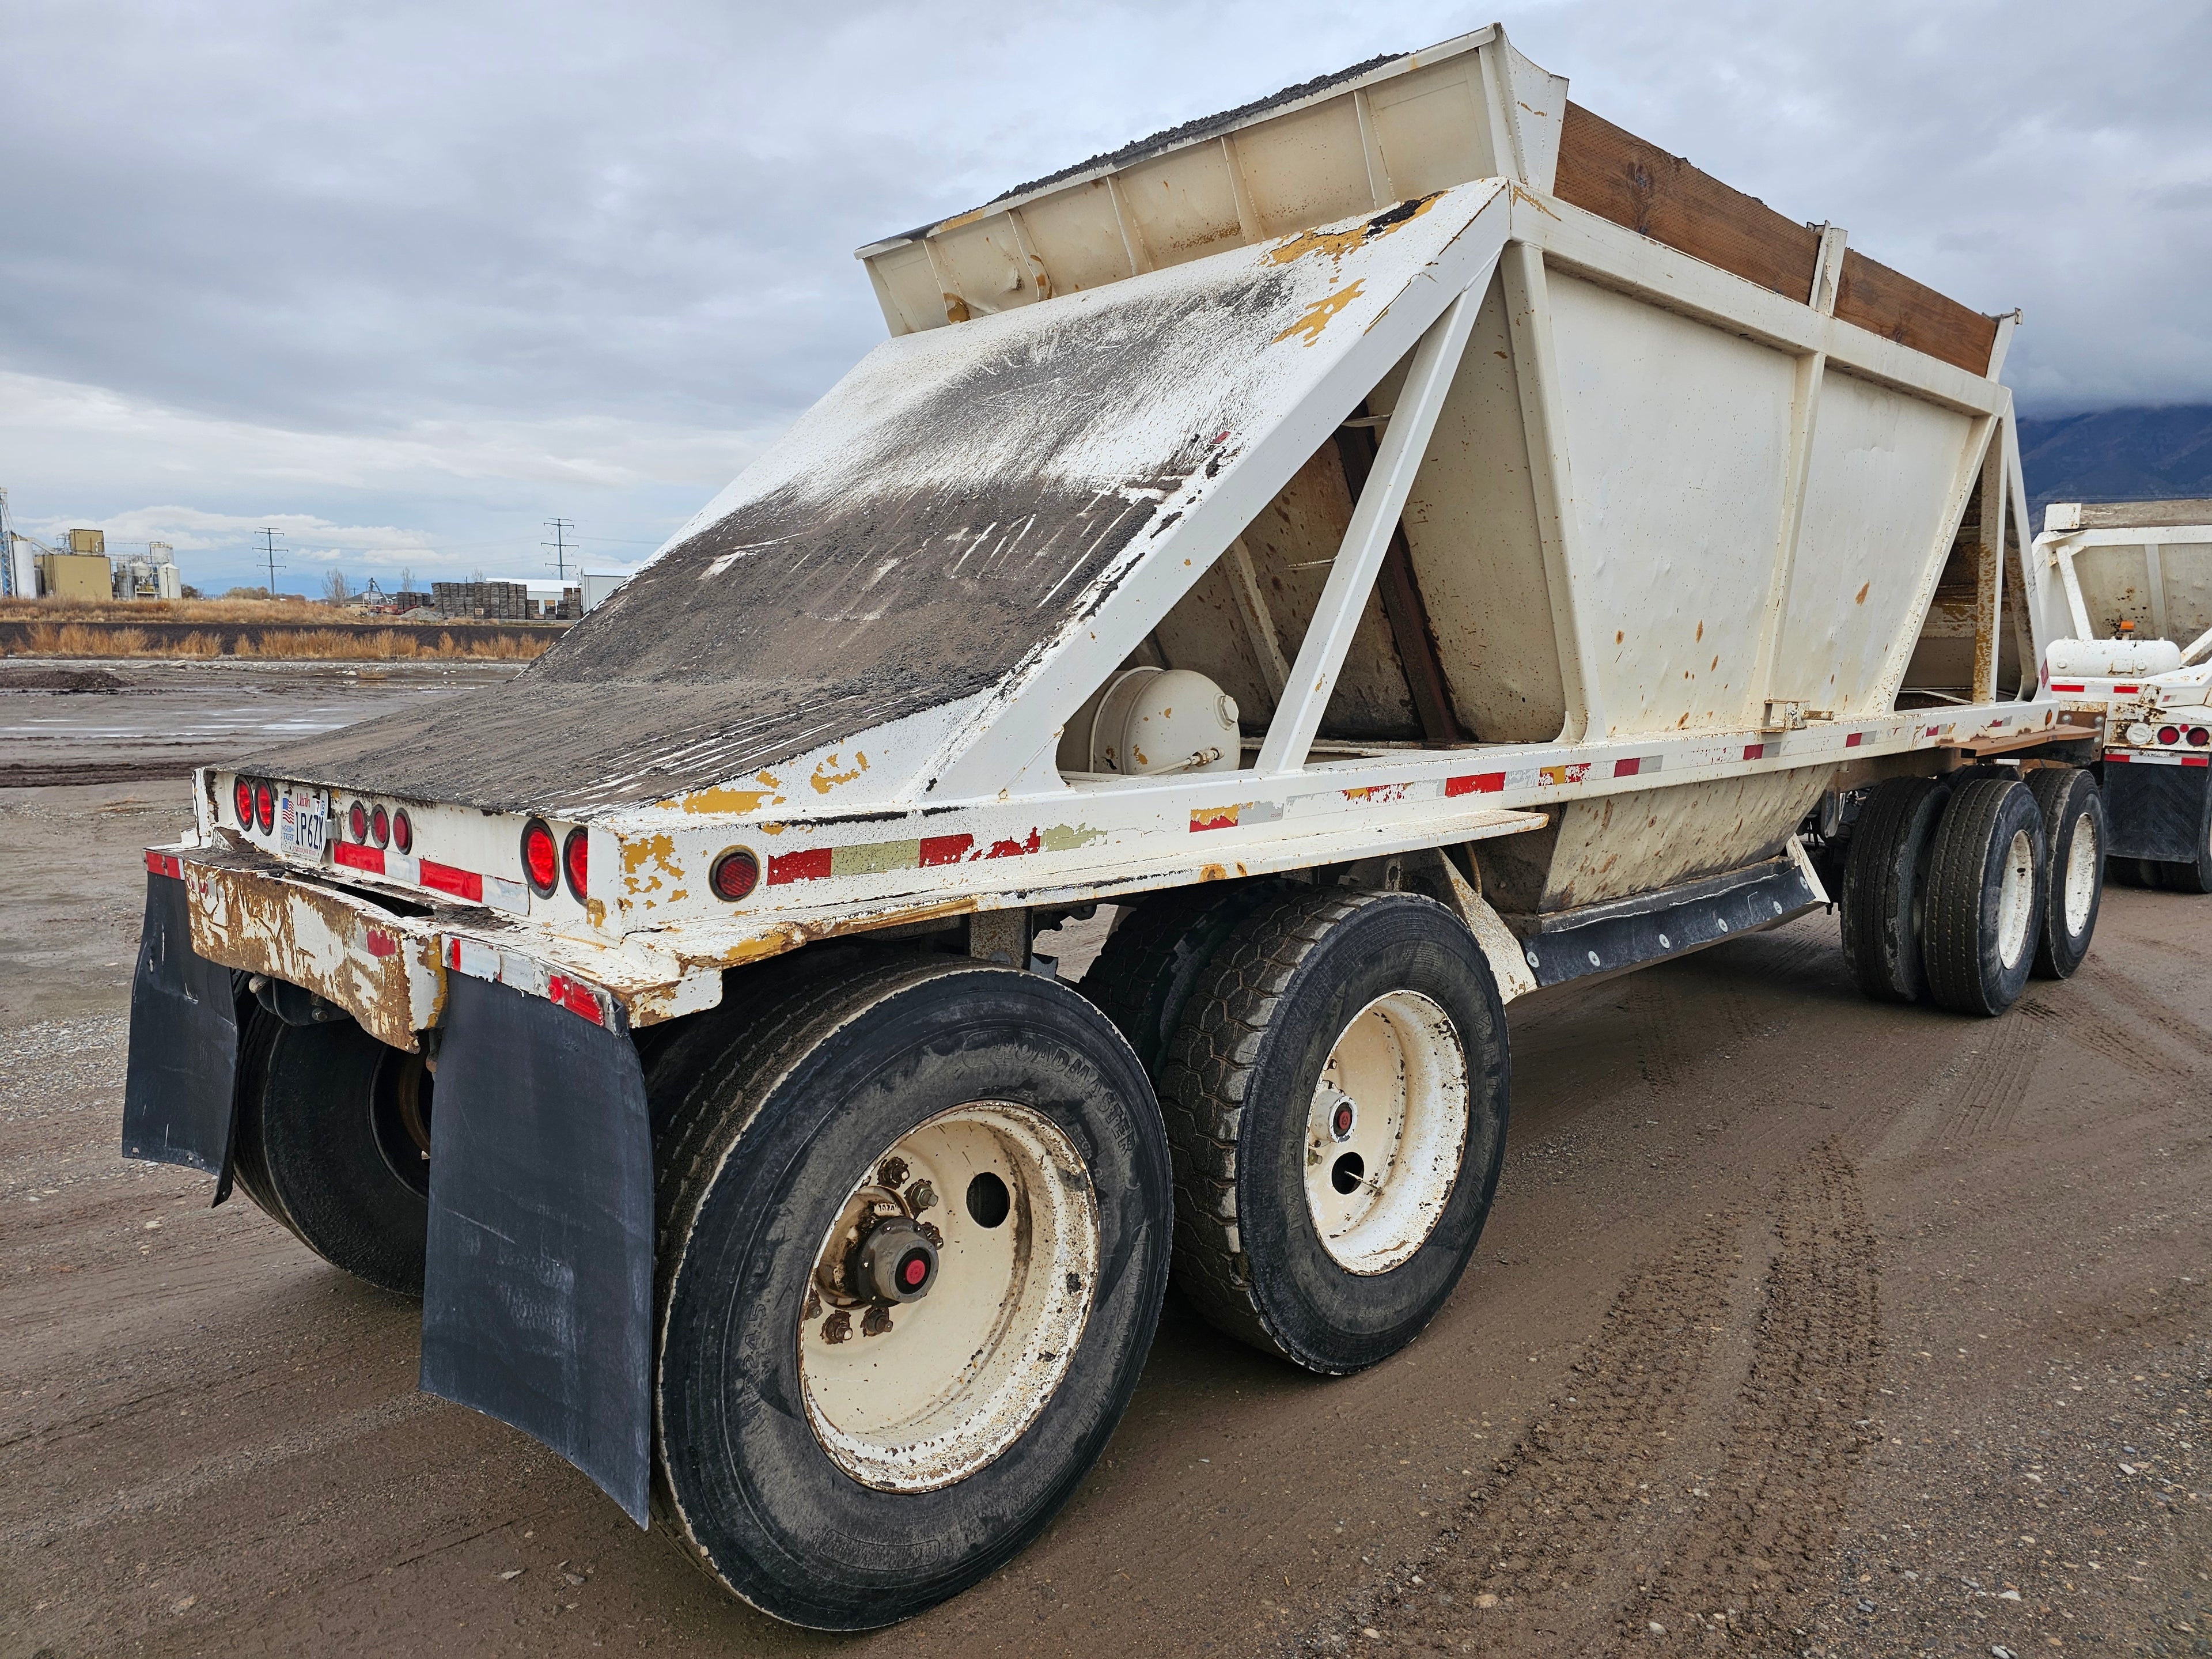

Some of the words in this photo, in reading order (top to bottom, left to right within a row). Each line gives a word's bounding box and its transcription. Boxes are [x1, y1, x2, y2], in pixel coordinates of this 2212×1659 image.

[297, 793, 310, 808] Utah
[316, 801, 320, 812] 7
[995, 1036, 1137, 1157] ROADMASTER
